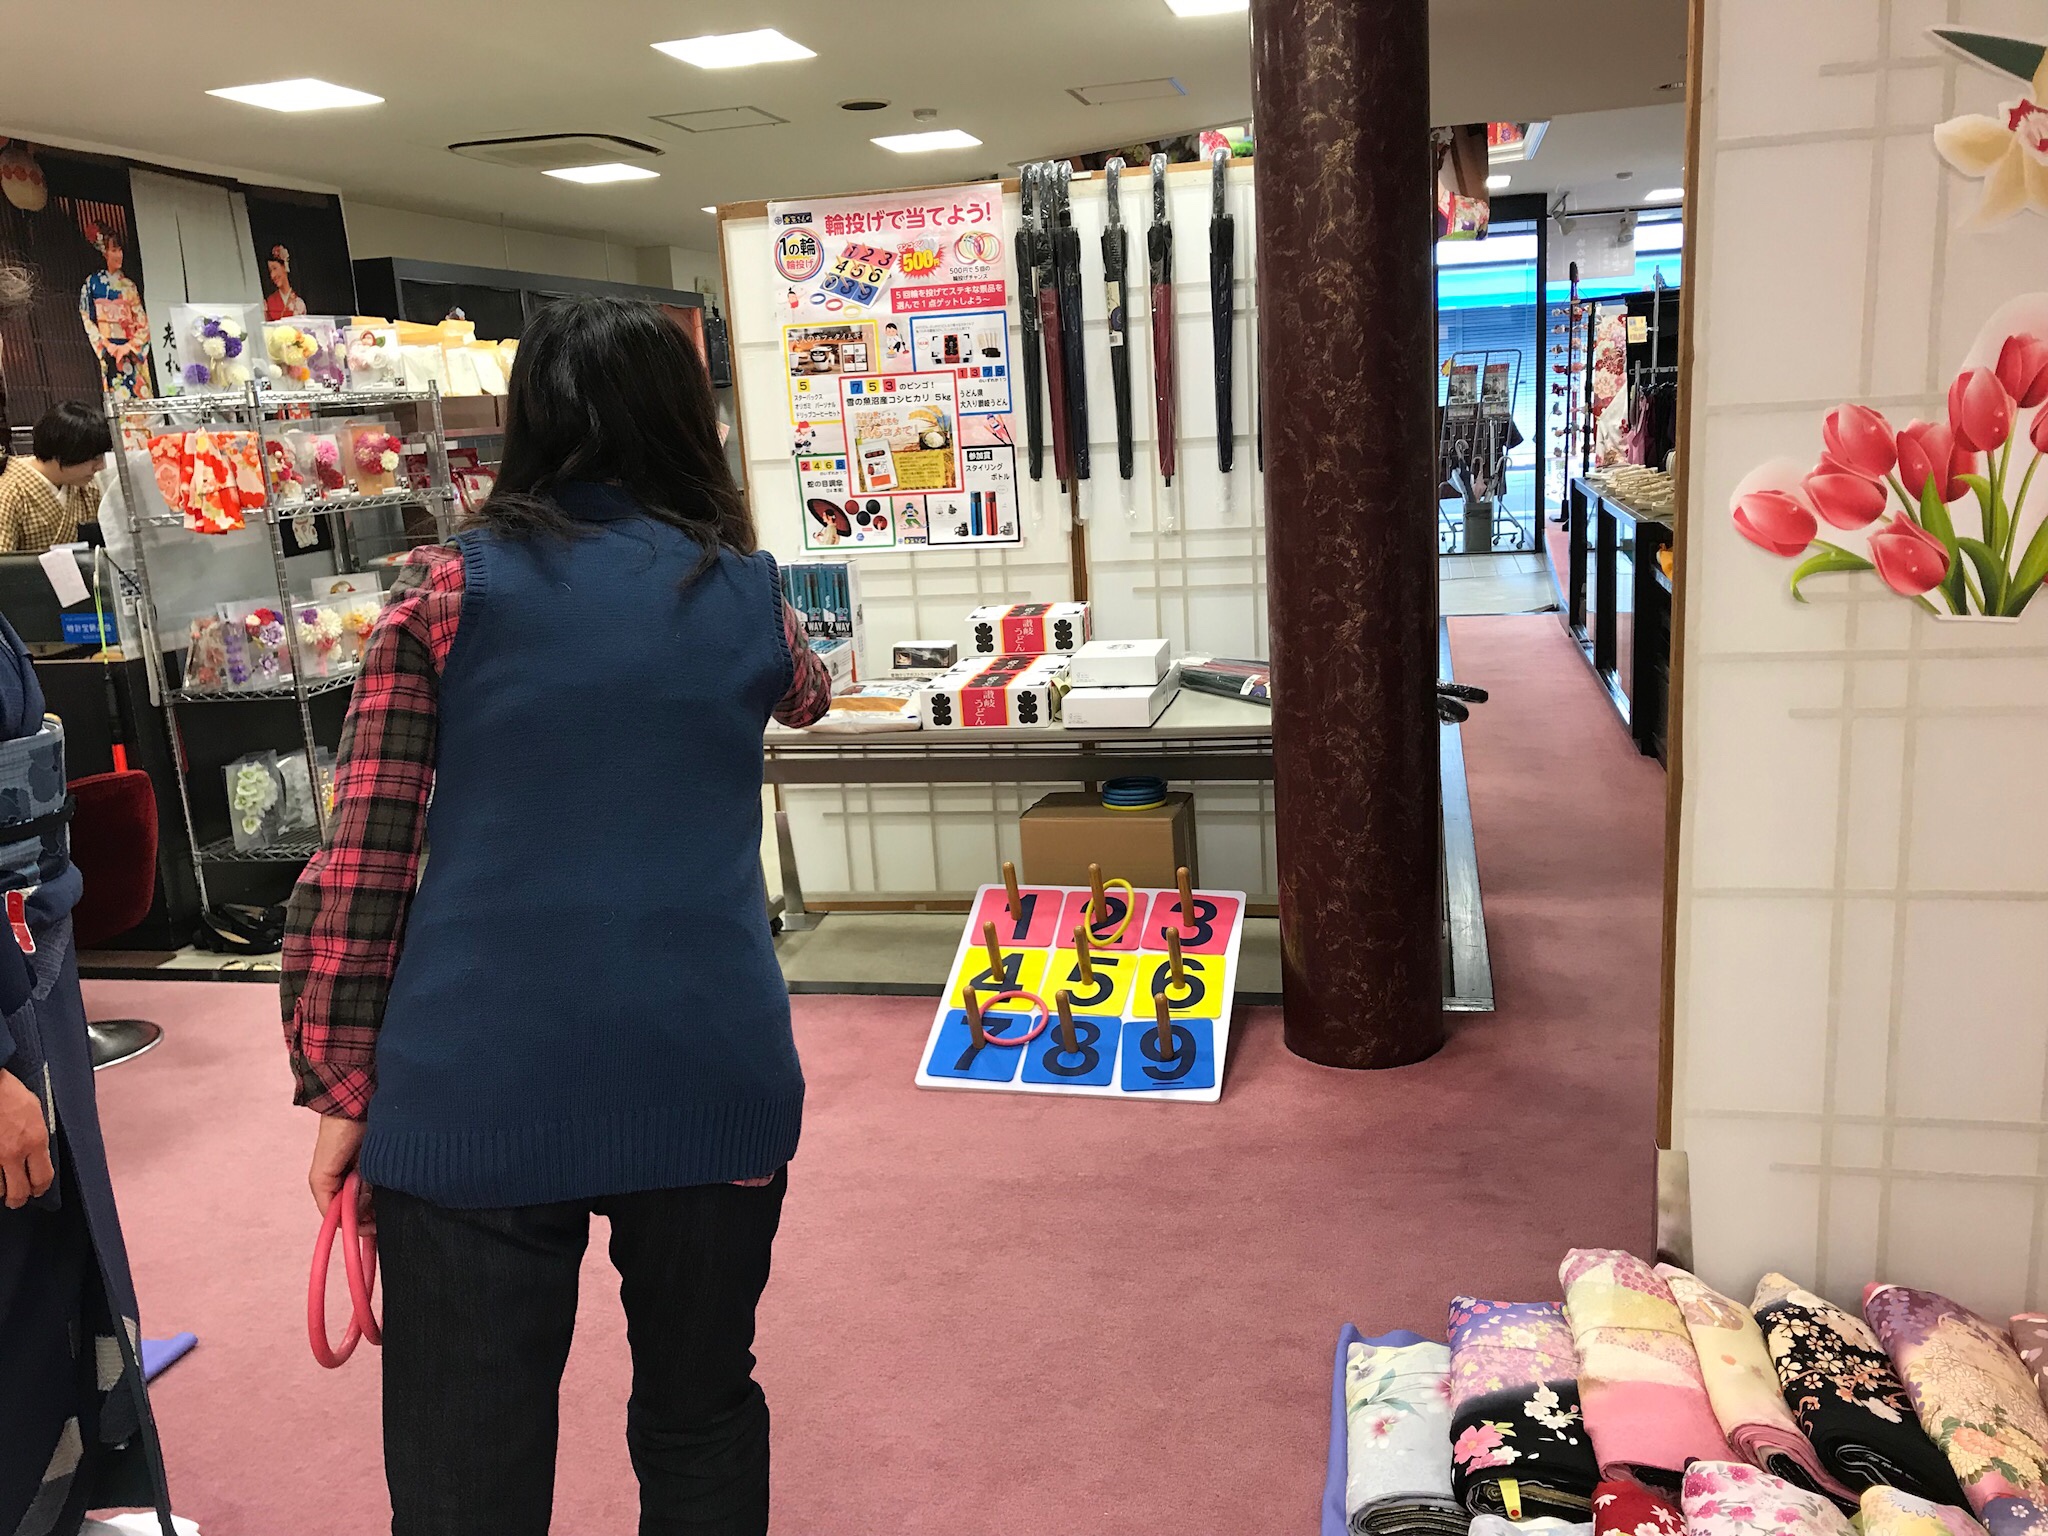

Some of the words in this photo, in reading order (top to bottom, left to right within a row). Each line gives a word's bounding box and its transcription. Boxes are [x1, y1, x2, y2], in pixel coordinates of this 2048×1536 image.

[824, 202, 991, 236] 輪投げで当てよう!
[779, 237, 816, 256] 1の輪
[786, 259, 814, 270] 輪投げ
[859, 248, 874, 262] 2
[878, 252, 893, 266] 3
[903, 249, 940, 272] 500円
[835, 260, 849, 273] 4
[868, 268, 883, 283] 6
[858, 285, 873, 301] 9
[799, 381, 807, 390] 5
[868, 382, 877, 391] 5
[885, 381, 893, 390] 3
[846, 394, 930, 407] 雪の魚沼産コシヒカリ
[935, 394, 951, 402] 5kg
[968, 451, 991, 460] 参加賞
[813, 462, 820, 470] 4
[965, 463, 1003, 472] スタイリング
[991, 473, 1010, 481] ボトル
[807, 622, 823, 632] WAY
[827, 621, 834, 633] 2
[835, 622, 850, 632] WAY
[1014, 627, 1025, 652] うどん
[974, 699, 986, 725] うどん
[1004, 894, 1039, 941] 1
[1071, 896, 1128, 944] 2
[1161, 899, 1218, 947] 3
[969, 953, 1024, 1003] 4
[1066, 957, 1119, 1007] 5
[1151, 958, 1206, 1009] 6
[953, 1015, 1013, 1071] 7
[1042, 1020, 1101, 1077] 8
[1139, 1024, 1197, 1081] 9
